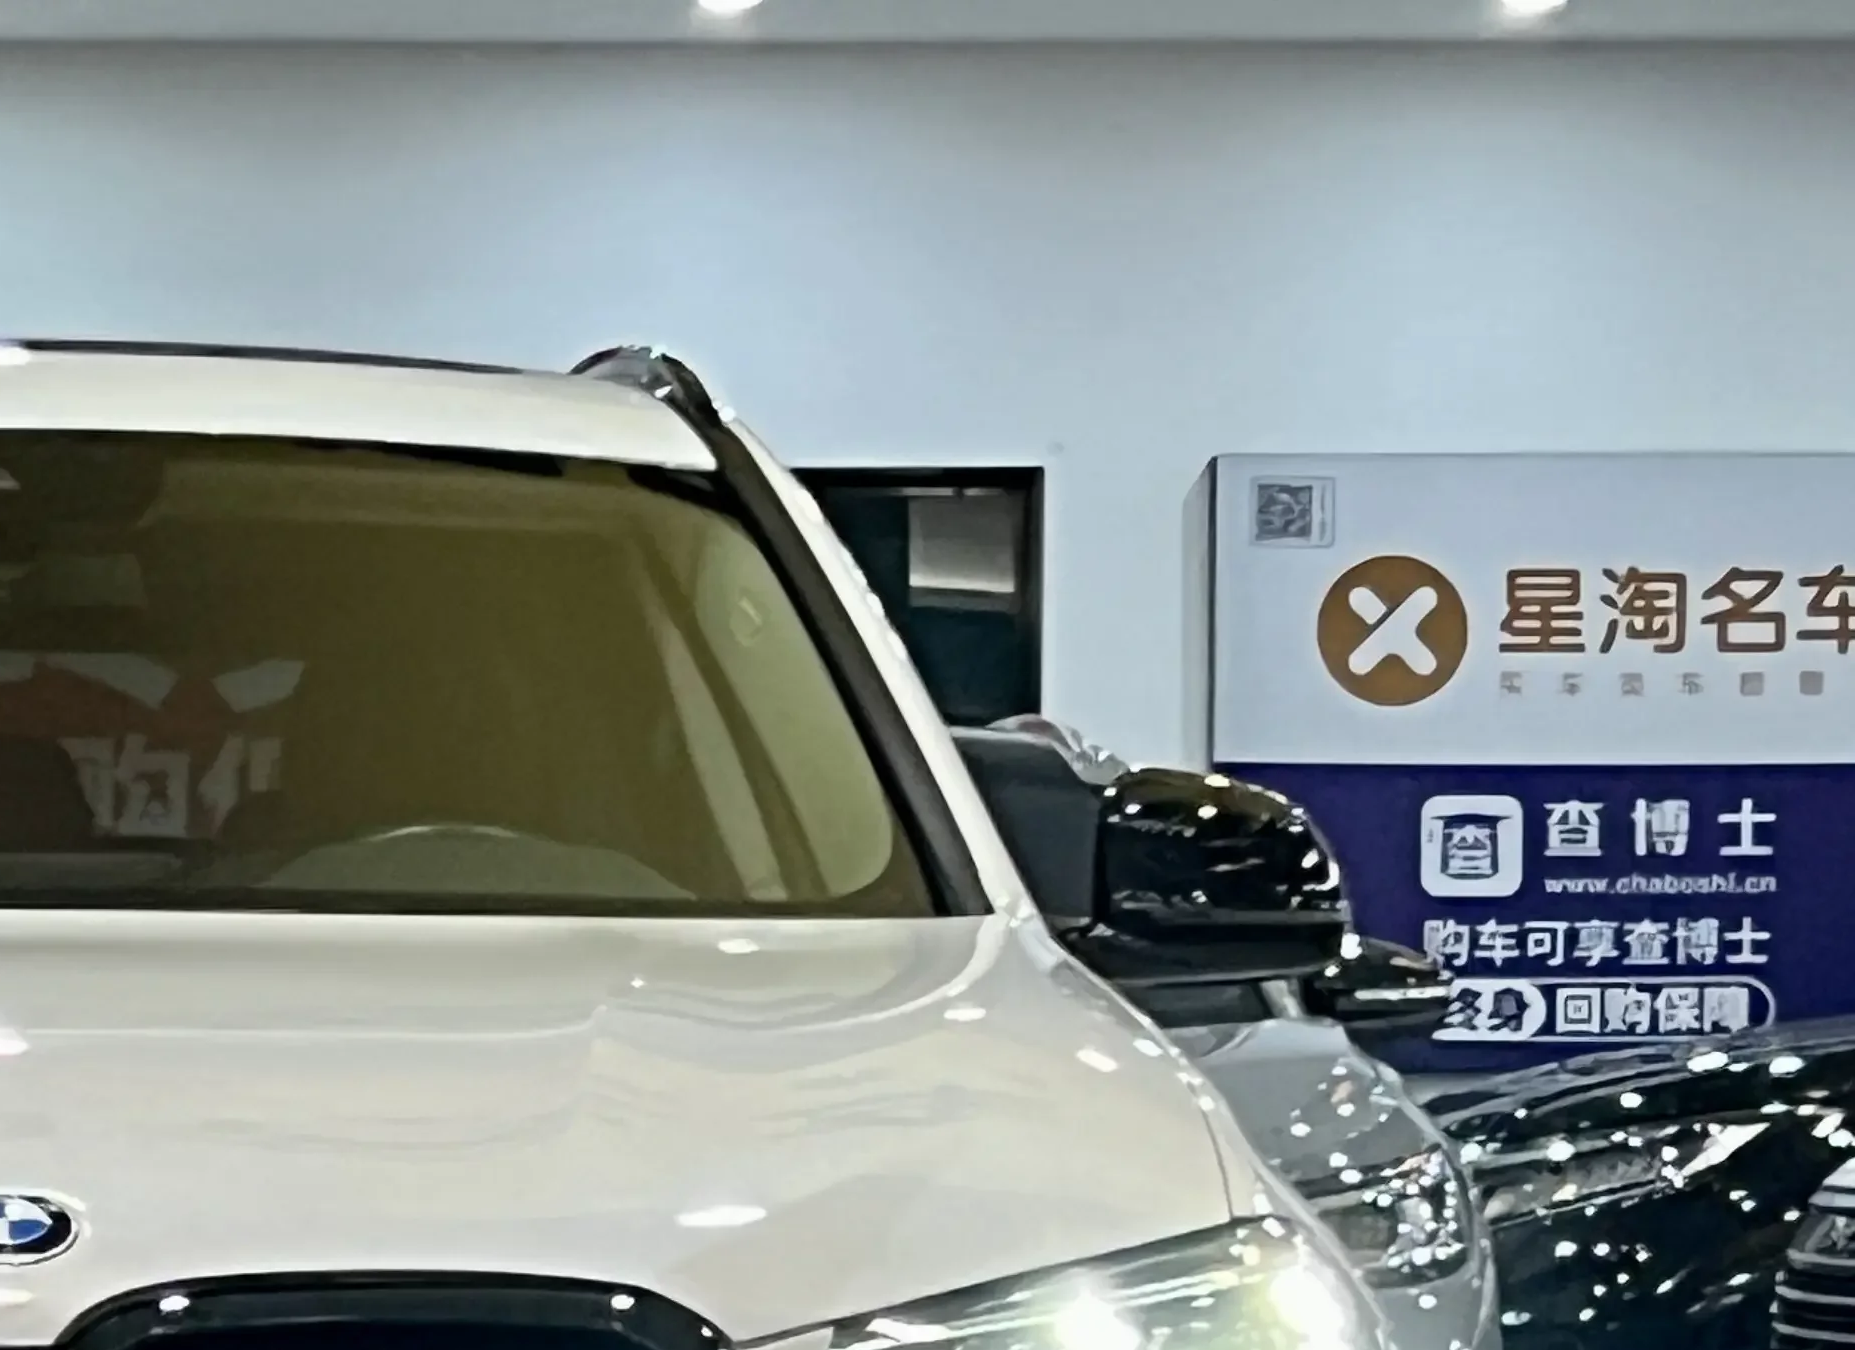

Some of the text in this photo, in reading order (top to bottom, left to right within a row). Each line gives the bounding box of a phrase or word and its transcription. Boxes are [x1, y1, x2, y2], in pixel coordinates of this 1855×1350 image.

[1498, 564, 1855, 655] 星淘名车
[1543, 797, 1777, 857] 查博士
